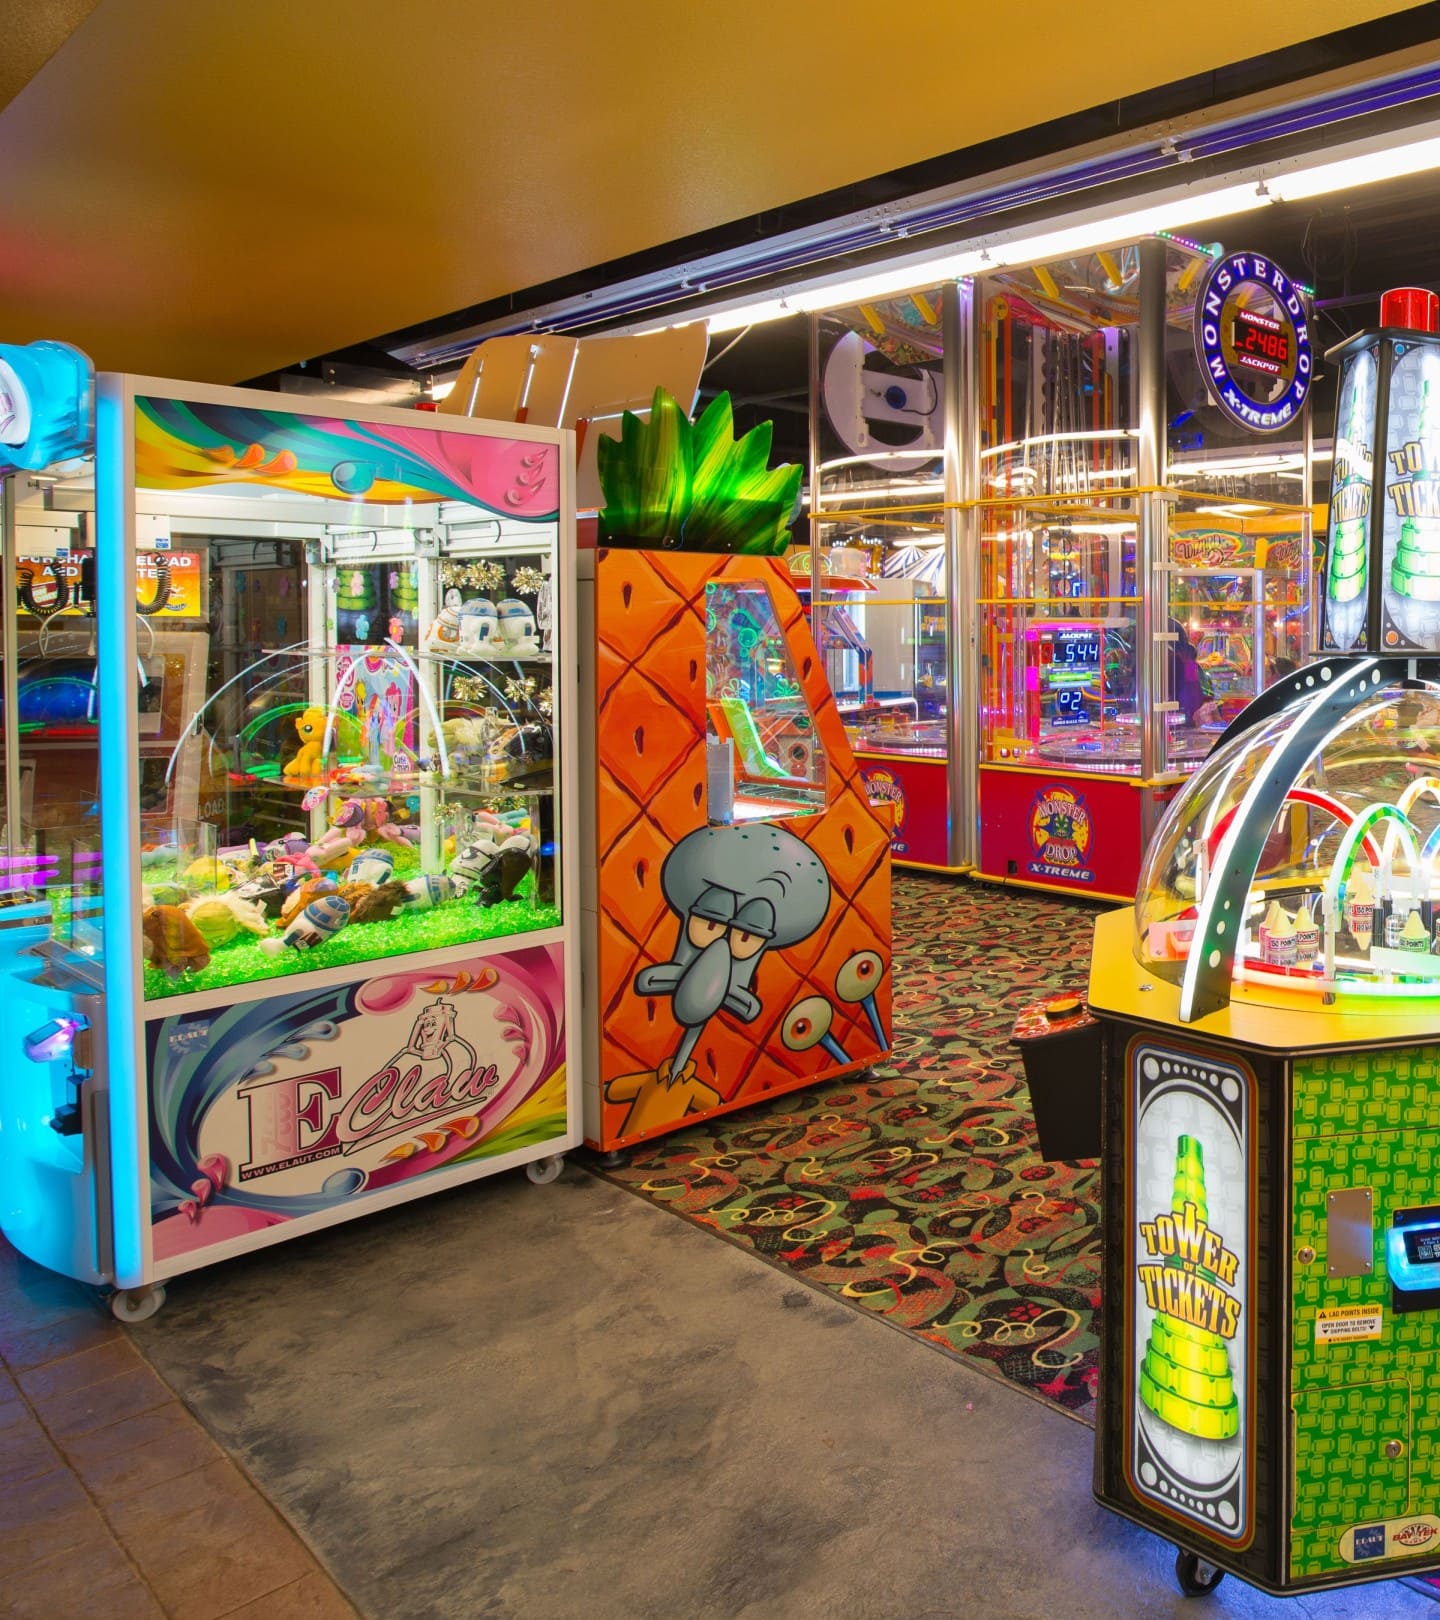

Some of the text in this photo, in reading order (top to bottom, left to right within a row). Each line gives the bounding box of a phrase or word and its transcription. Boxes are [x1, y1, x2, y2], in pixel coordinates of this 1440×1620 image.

[1204, 258, 1285, 379] MONSTER
[1240, 311, 1280, 331] MONSTER
[1240, 355, 1280, 373] JACKPOT
[1223, 388, 1292, 426] X-TREME
[1037, 798, 1087, 825] MONSTER
[1046, 842, 1077, 861] DROP
[1031, 862, 1091, 880] X-TREME
[237, 1063, 499, 1172] E Claw
[240, 1146, 342, 1181] WWW.ELAUT.COM
[1140, 1201, 1240, 1287] TOWER
[1138, 1264, 1241, 1340] TICKETS
[1362, 1307, 1379, 1316] INSIDE
